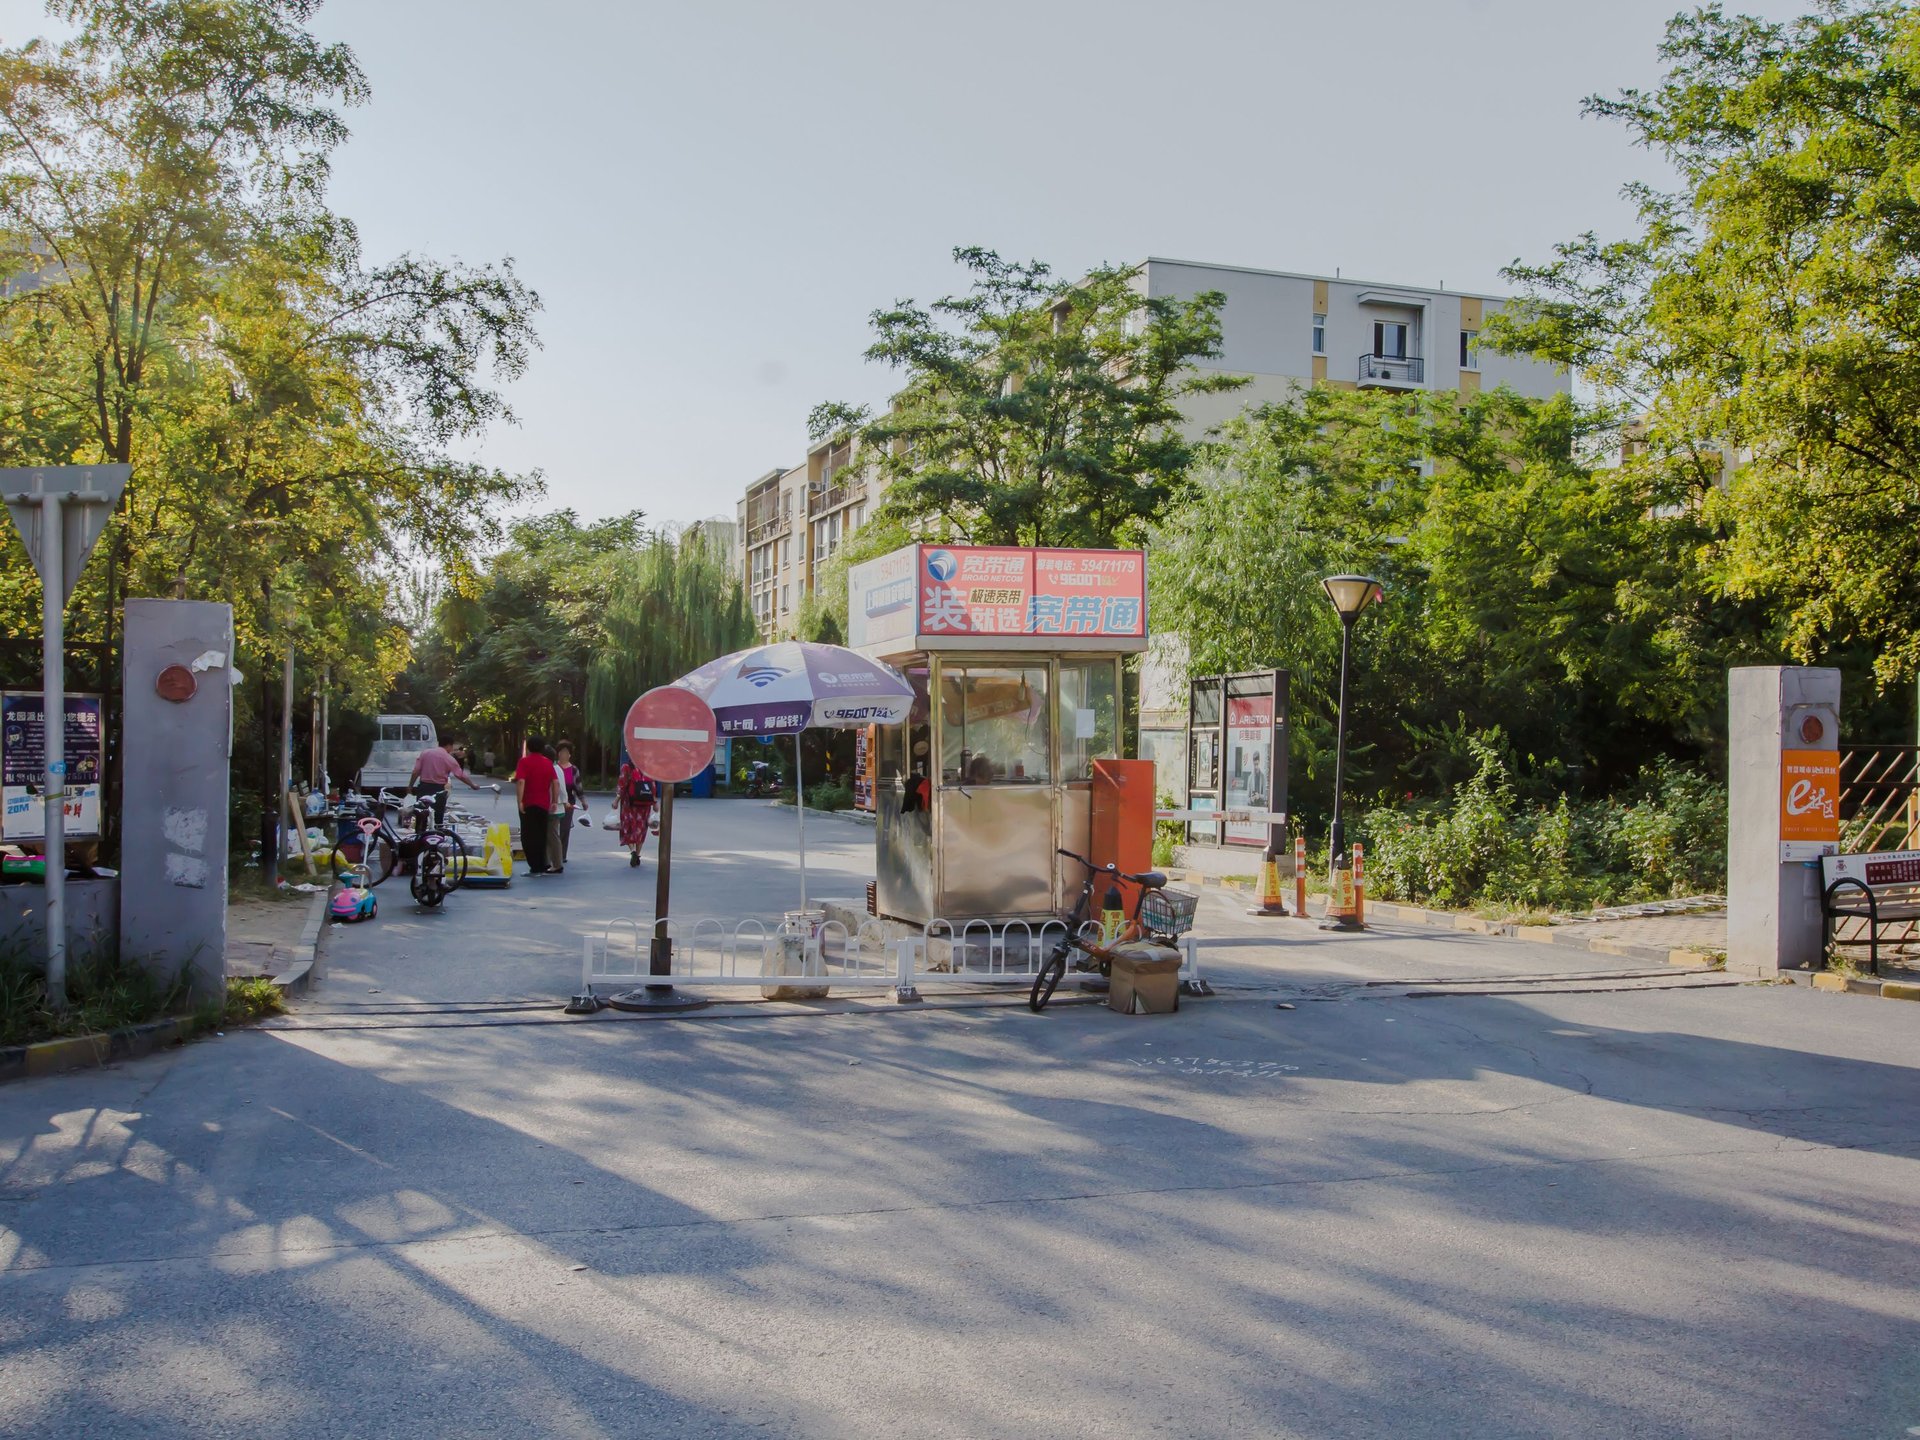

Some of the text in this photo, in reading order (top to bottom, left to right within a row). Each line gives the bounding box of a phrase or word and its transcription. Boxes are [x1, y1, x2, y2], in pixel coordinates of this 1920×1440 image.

[962, 555, 1026, 575] 宽带通
[1080, 559, 1136, 573] 59471179
[961, 574, 1023, 583] BROAD NETCOM
[1060, 574, 1101, 586] 96007
[970, 589, 1022, 604] 极速宽带
[924, 586, 967, 631] 装
[1023, 594, 1141, 634] 宽带通
[970, 607, 1021, 632] 就选
[6, 711, 97, 722] 龙园派出您提示
[836, 707, 877, 719] 96007
[1239, 715, 1270, 725] ARISTON
[7, 803, 30, 814] 20M
